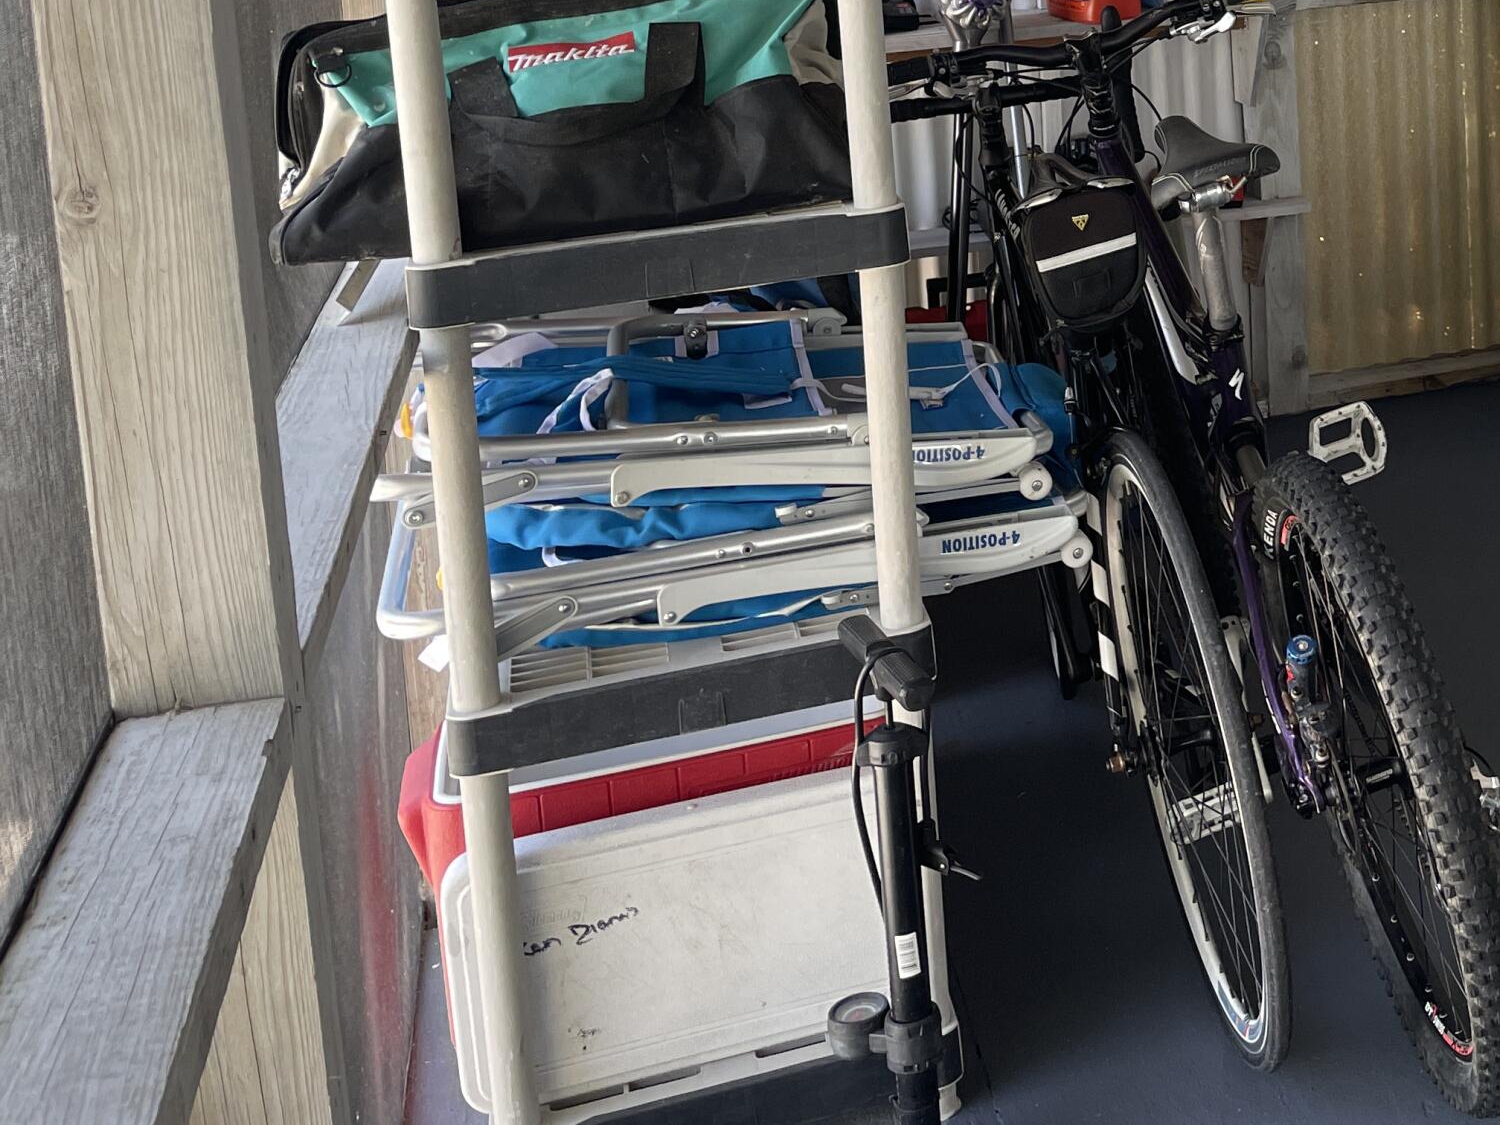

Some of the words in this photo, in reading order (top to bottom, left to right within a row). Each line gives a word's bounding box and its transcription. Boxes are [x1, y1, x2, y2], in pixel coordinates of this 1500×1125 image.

[912, 445, 985, 463] 4-POSITIO
[942, 530, 1021, 554] 4-POSITION
[1263, 509, 1278, 560] KENDA
